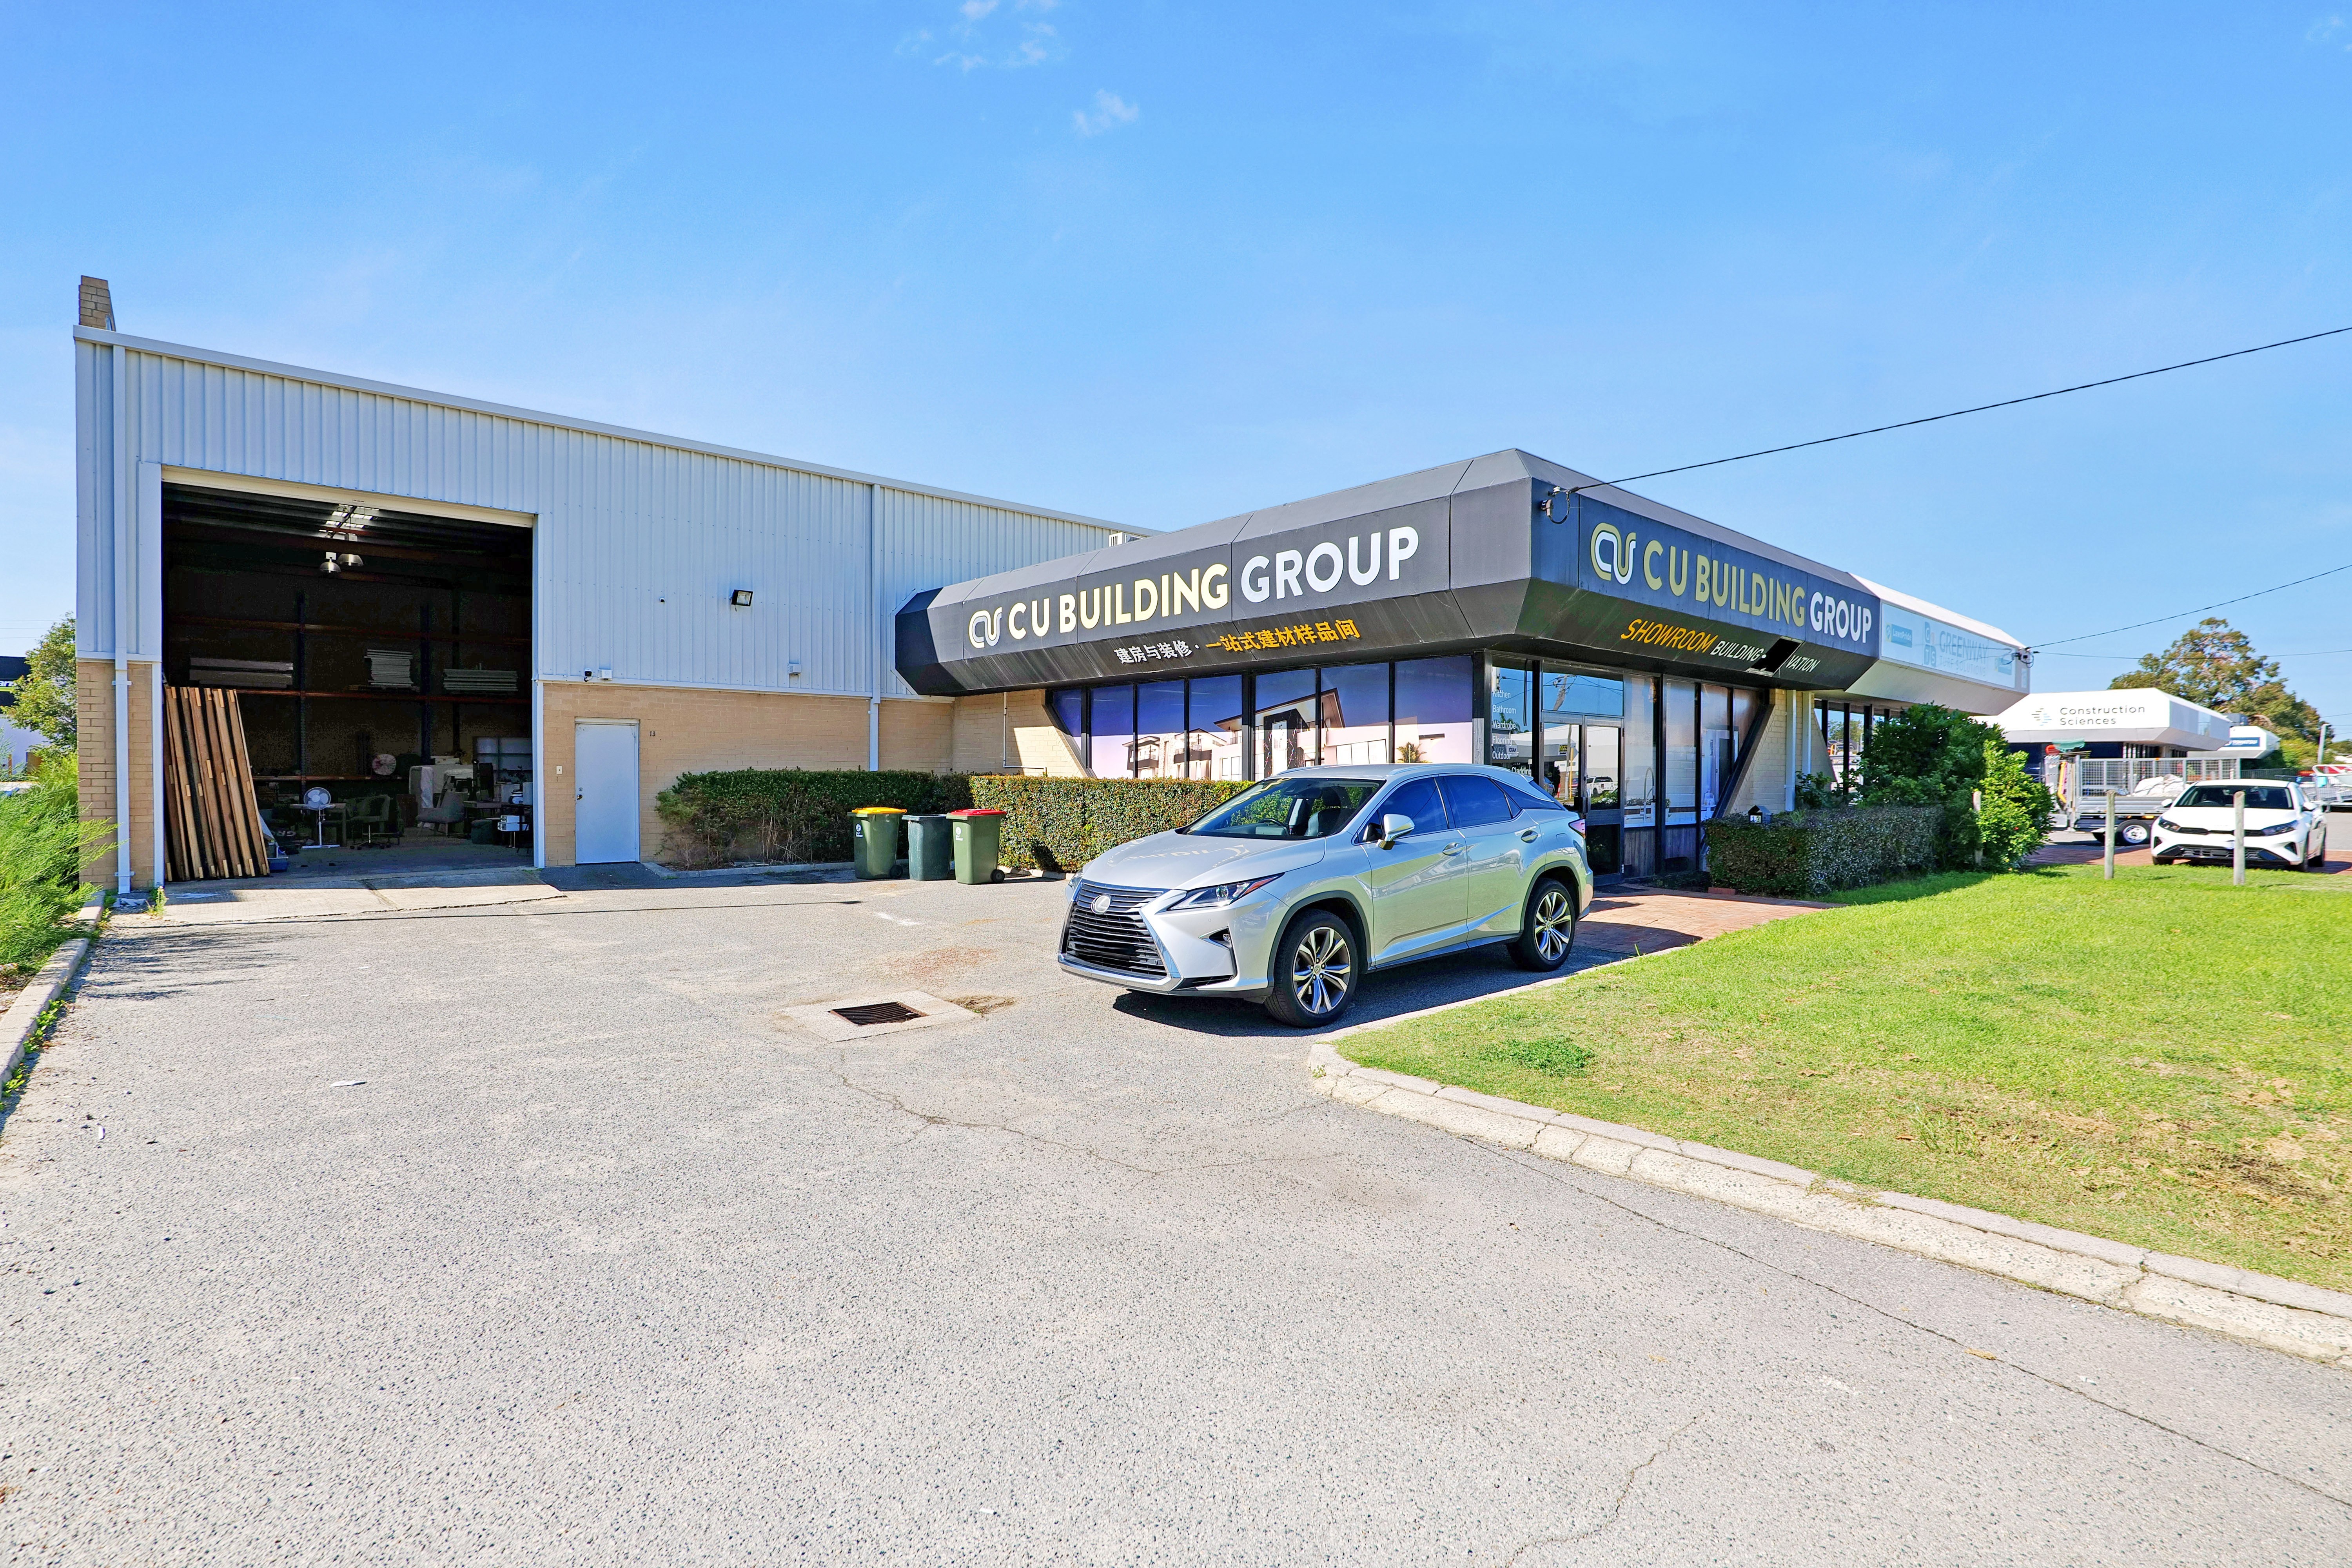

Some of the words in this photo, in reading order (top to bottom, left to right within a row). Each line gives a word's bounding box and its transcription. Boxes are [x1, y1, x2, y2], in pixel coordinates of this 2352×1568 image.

[1060, 563, 1229, 633] BUILDING
[1241, 526, 1419, 603] GROUP
[1695, 554, 1805, 626] BUILDING
[1810, 592, 1872, 643] GROUP
[1621, 619, 1718, 653] SHOWROOM
[1893, 628, 1912, 641] LawnPride
[1940, 631, 1988, 664] GREENWAY
[1956, 660, 1986, 677] SOLUTIONS
[1493, 690, 1511, 698] Kitchen
[1493, 704, 1516, 714] Bathroom
[2060, 706, 2145, 715] Construction
[1492, 720, 1516, 729] Wardrobe
[1492, 735, 1512, 746] Flooring
[1492, 751, 1512, 760] Outdoor
[1512, 767, 1532, 777] Cladding
